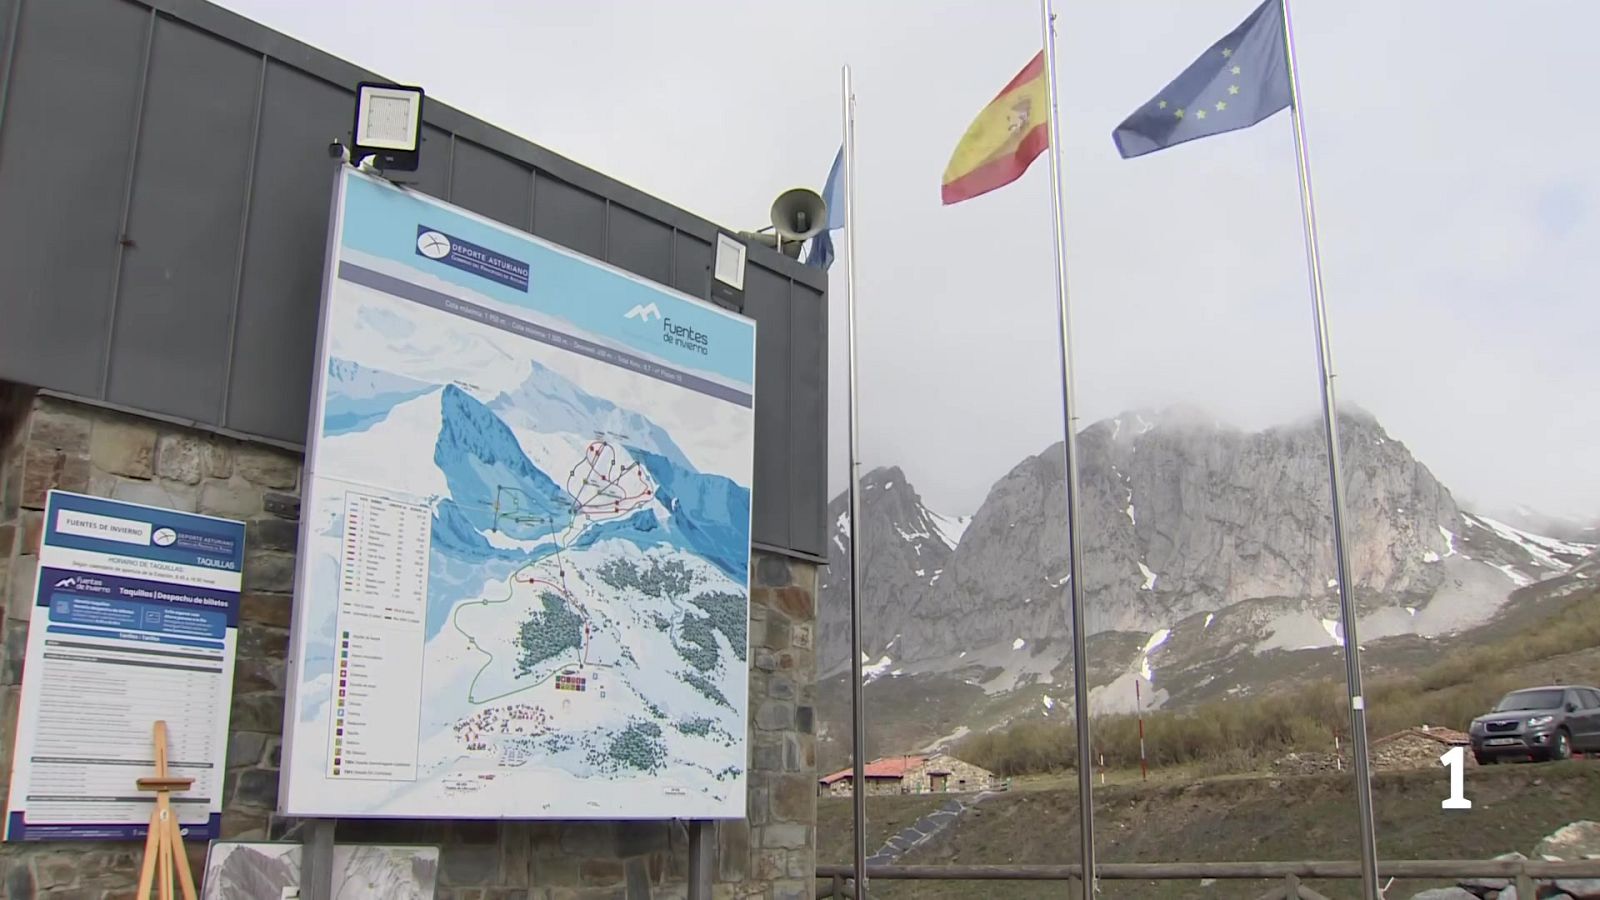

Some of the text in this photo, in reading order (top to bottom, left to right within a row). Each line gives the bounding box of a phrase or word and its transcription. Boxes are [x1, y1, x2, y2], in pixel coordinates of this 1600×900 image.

[452, 243, 528, 277] DEPORTE ASTURIANO
[445, 299, 458, 311] Cota
[663, 317, 709, 346] Fuentes
[663, 333, 708, 356] de invierno
[66, 518, 143, 537] FUENTES DE INVIERNO
[108, 556, 138, 567] HORARIO
[139, 560, 147, 568] DE
[196, 556, 235, 570] TAQUILLAS
[76, 576, 103, 586] Fuentes
[85, 584, 111, 594] invierno
[119, 587, 153, 598] Taquillas
[157, 592, 193, 603] Despachu
[194, 596, 203, 604] de
[203, 598, 229, 608] billetes
